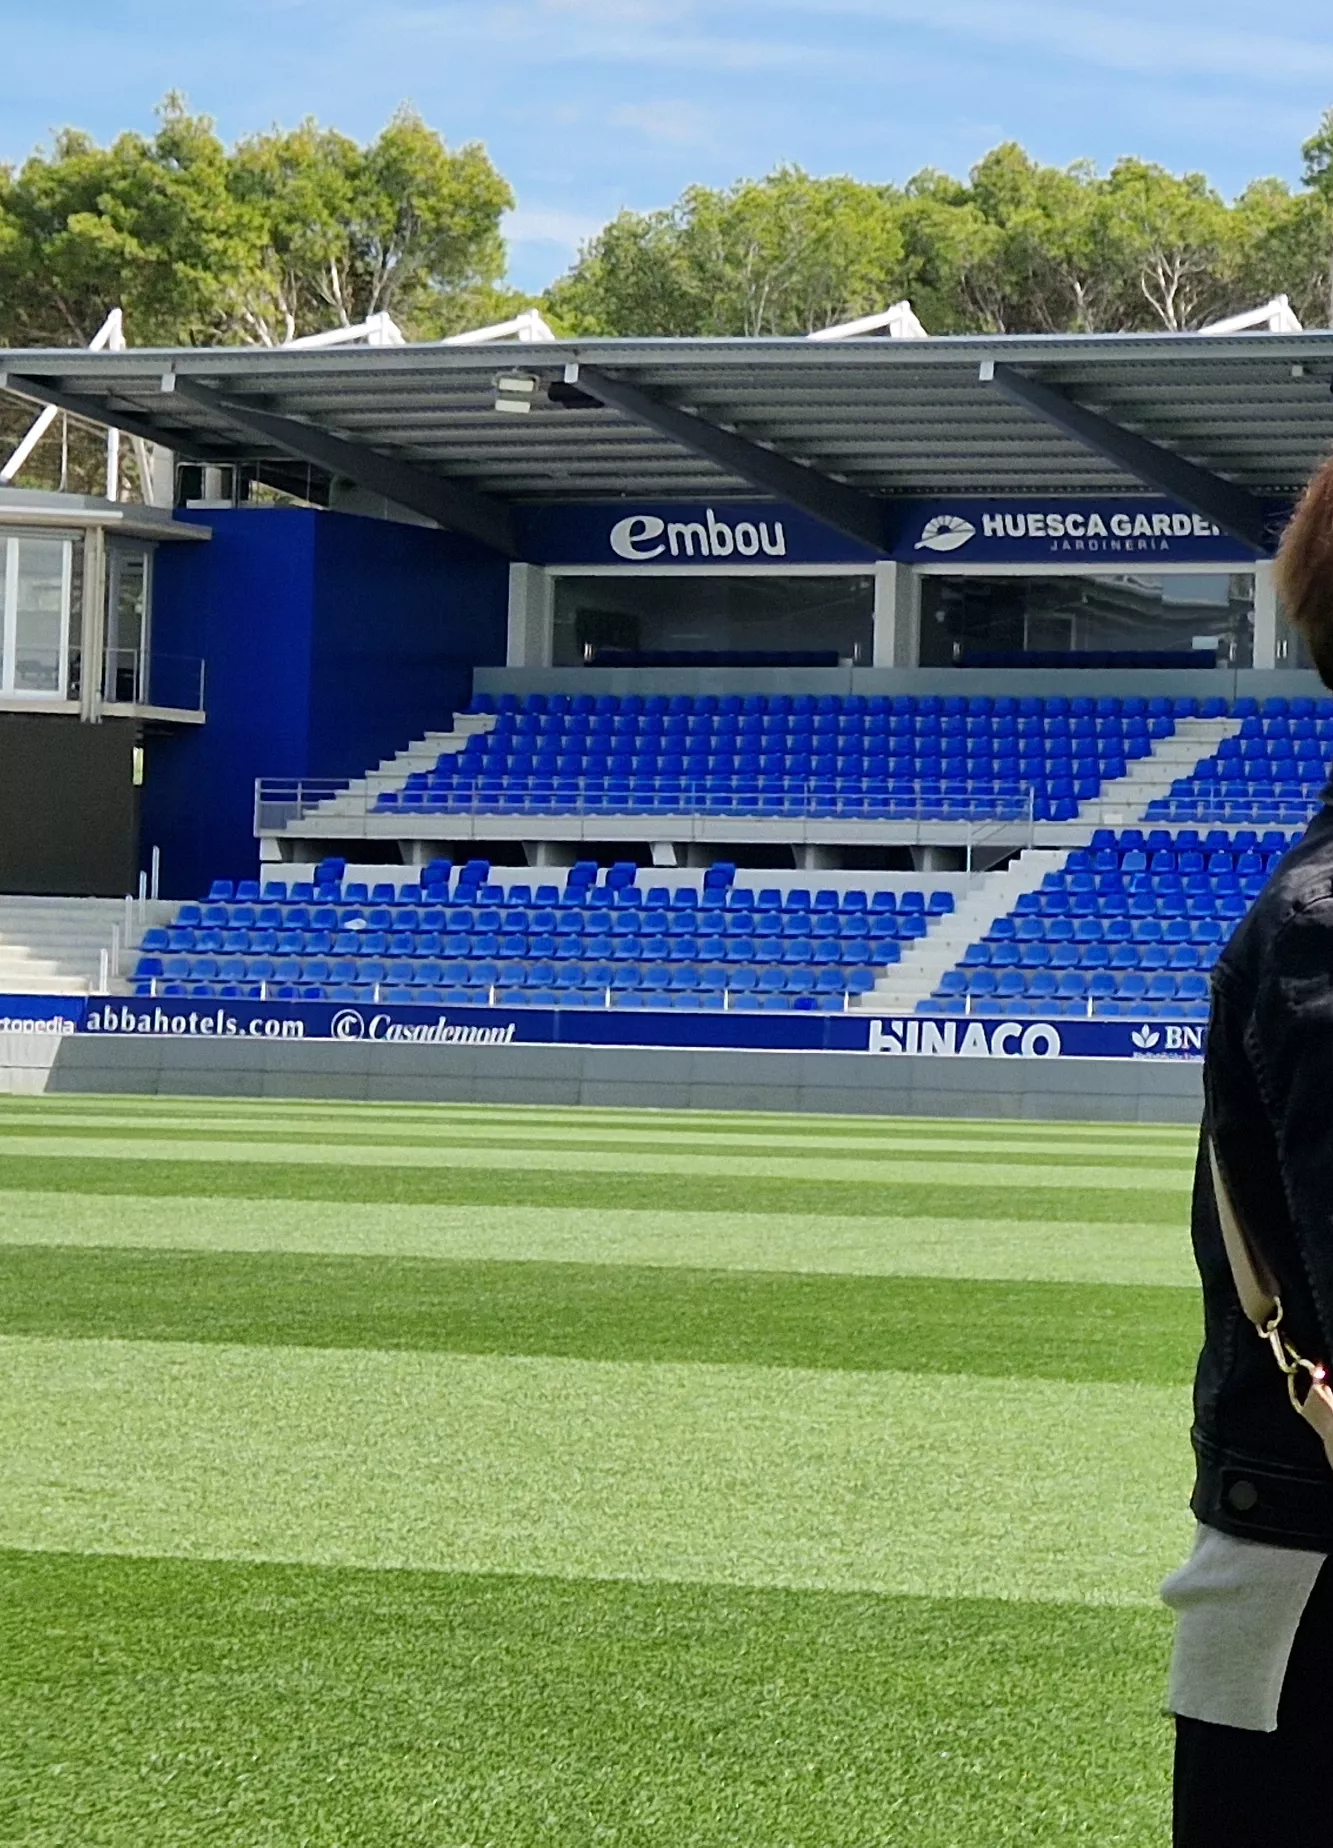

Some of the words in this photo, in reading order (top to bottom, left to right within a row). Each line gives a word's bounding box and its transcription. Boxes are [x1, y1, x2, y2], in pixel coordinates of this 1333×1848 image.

[610, 508, 787, 560] embou
[981, 513, 1108, 537] HUESCA
[1110, 513, 1221, 537] GARDE
[86, 1004, 305, 1038] abbahotels.com
[368, 1013, 516, 1043] Casademont
